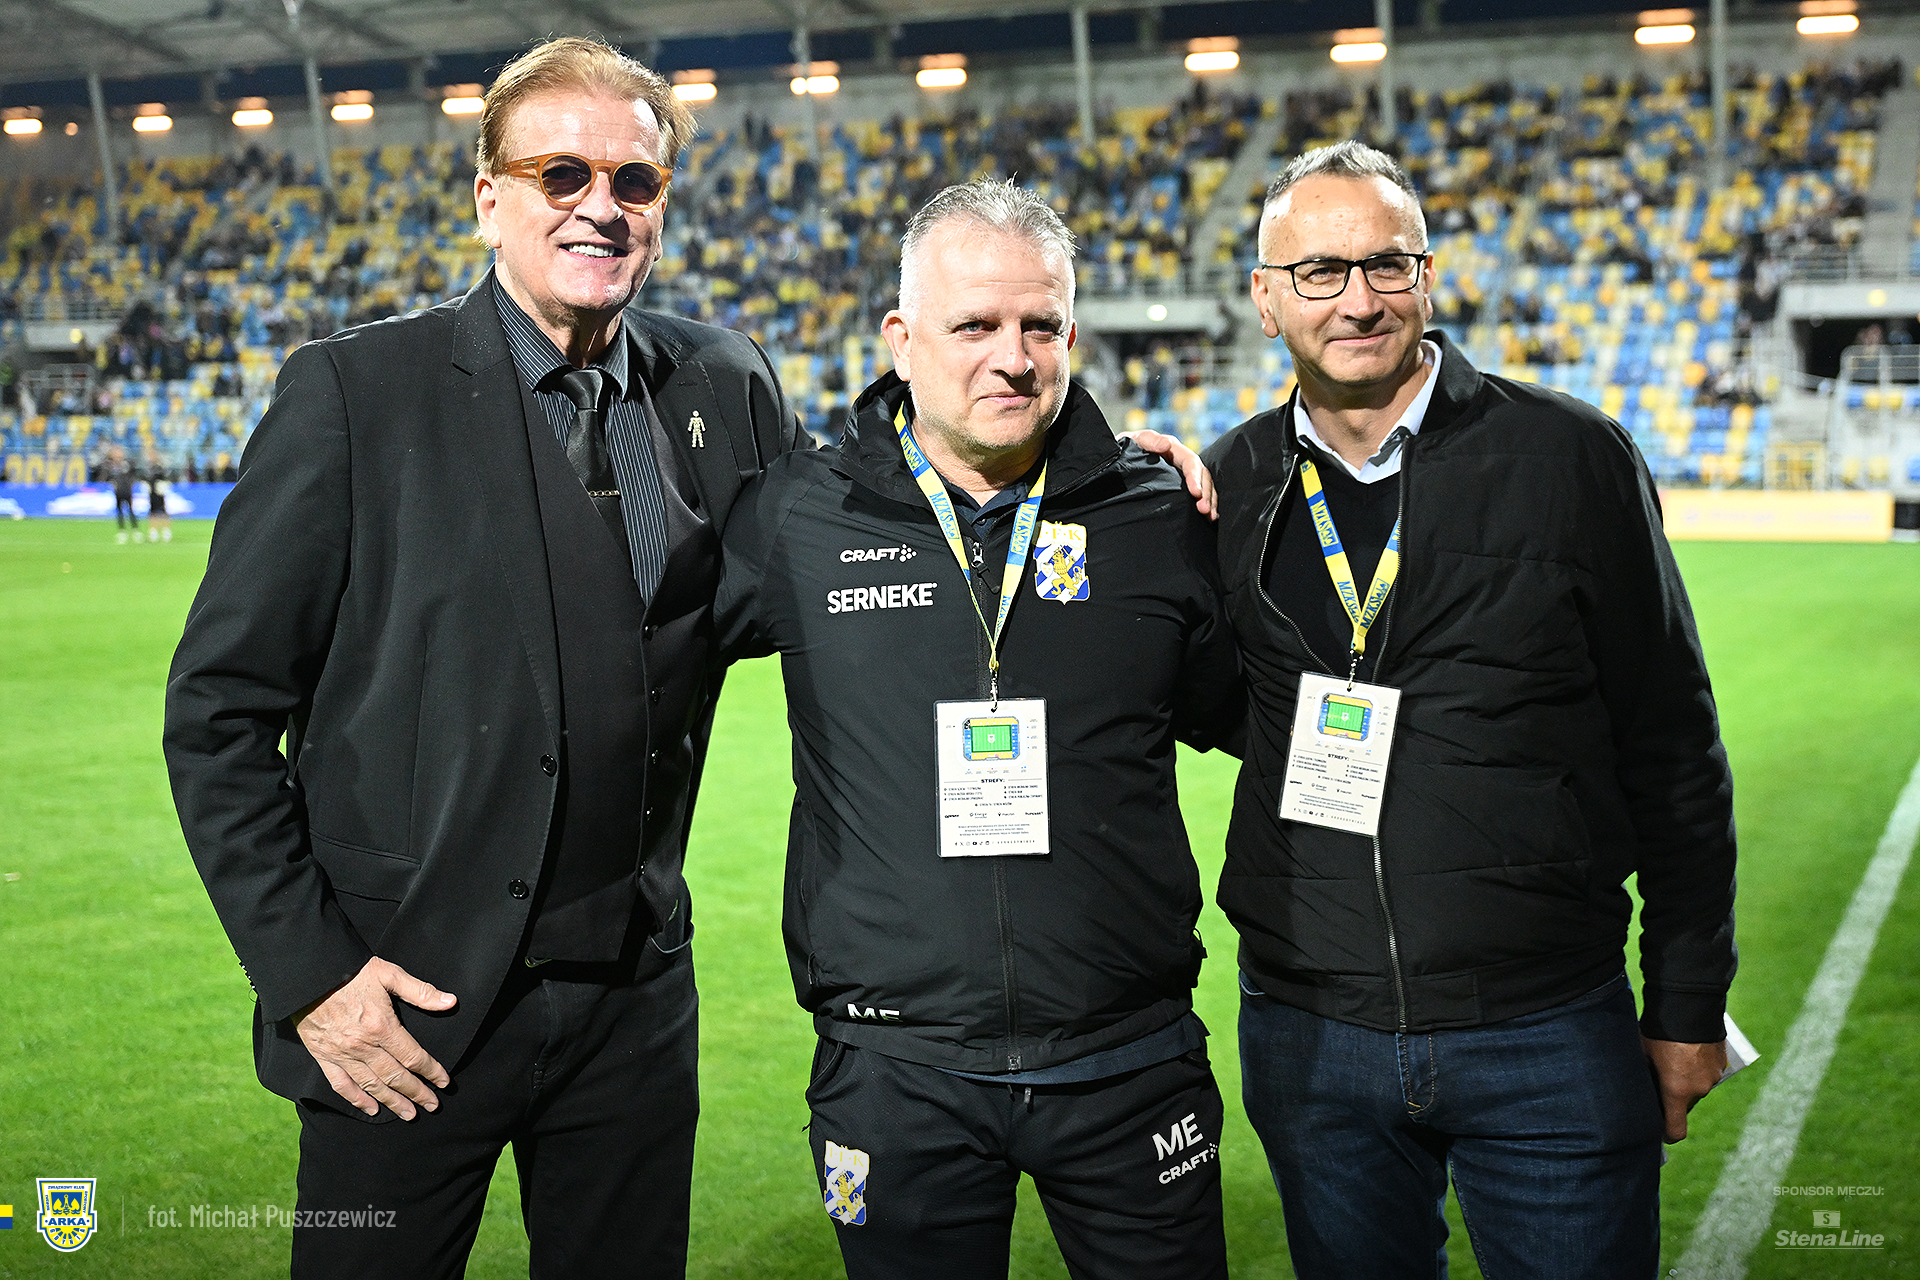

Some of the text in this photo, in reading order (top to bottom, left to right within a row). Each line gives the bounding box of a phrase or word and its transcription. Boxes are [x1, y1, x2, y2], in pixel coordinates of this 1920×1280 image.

[929, 491, 954, 522] MZKS
[839, 547, 900, 563] CRAFT
[827, 582, 935, 614] SERNEKE
[1336, 580, 1359, 610] MZKS
[1359, 595, 1382, 630] MZKS
[1151, 1112, 1203, 1161] ME
[1158, 1149, 1209, 1184] CRAFT
